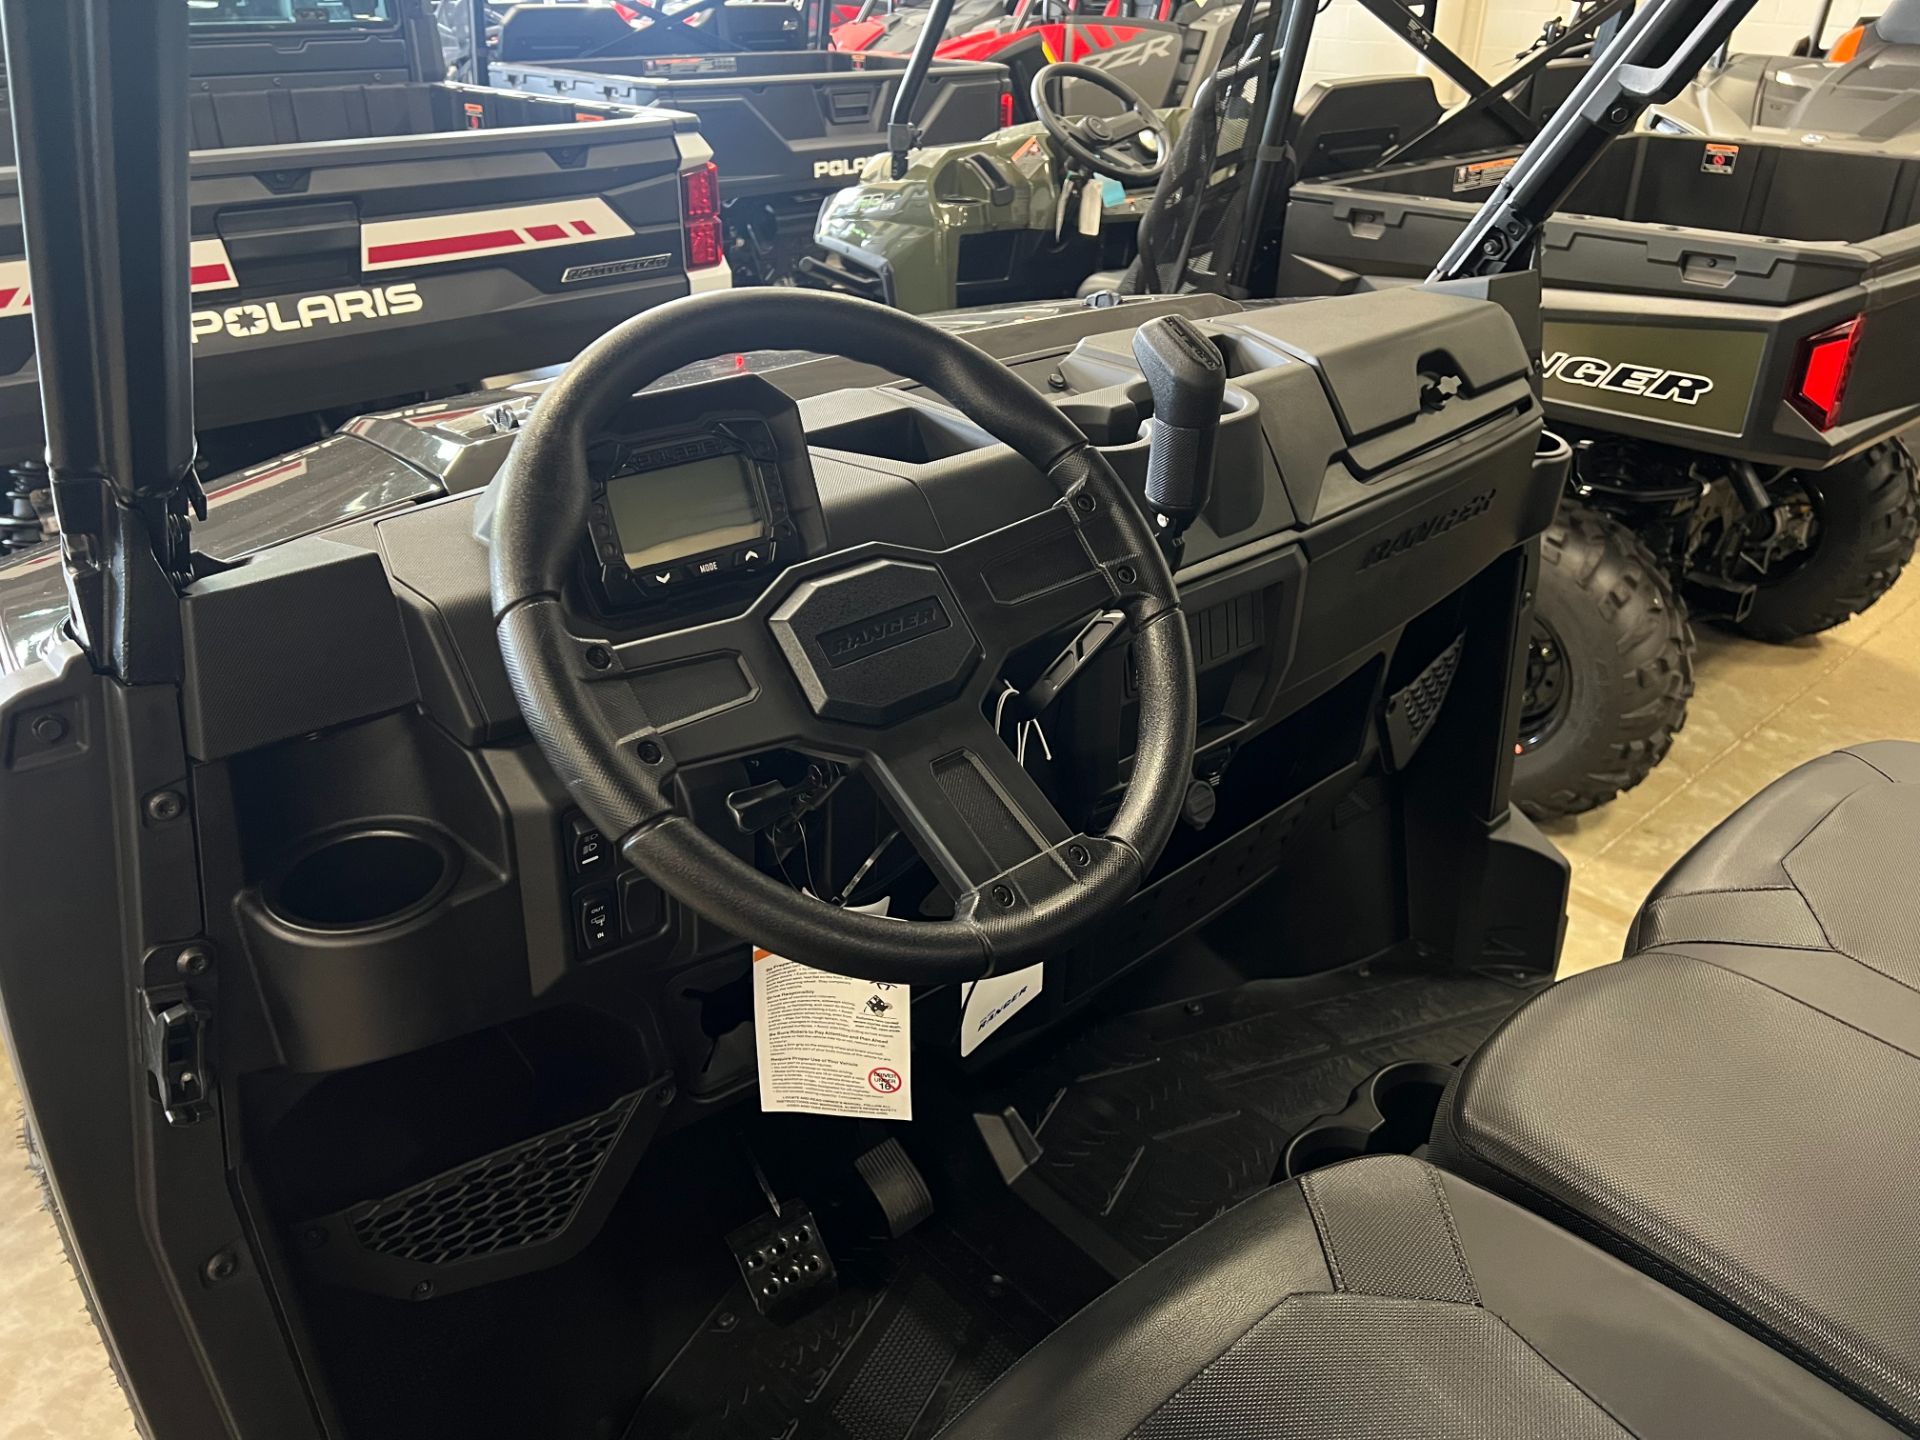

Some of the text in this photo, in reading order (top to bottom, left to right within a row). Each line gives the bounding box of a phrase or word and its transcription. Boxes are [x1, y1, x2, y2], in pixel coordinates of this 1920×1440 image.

[813, 157, 873, 178] POLA
[191, 283, 423, 344] POLARIS
[1542, 350, 1714, 405] NGER
[699, 561, 719, 574] MODE
[831, 608, 938, 657] RANGER
[879, 1082, 891, 1091] 16
